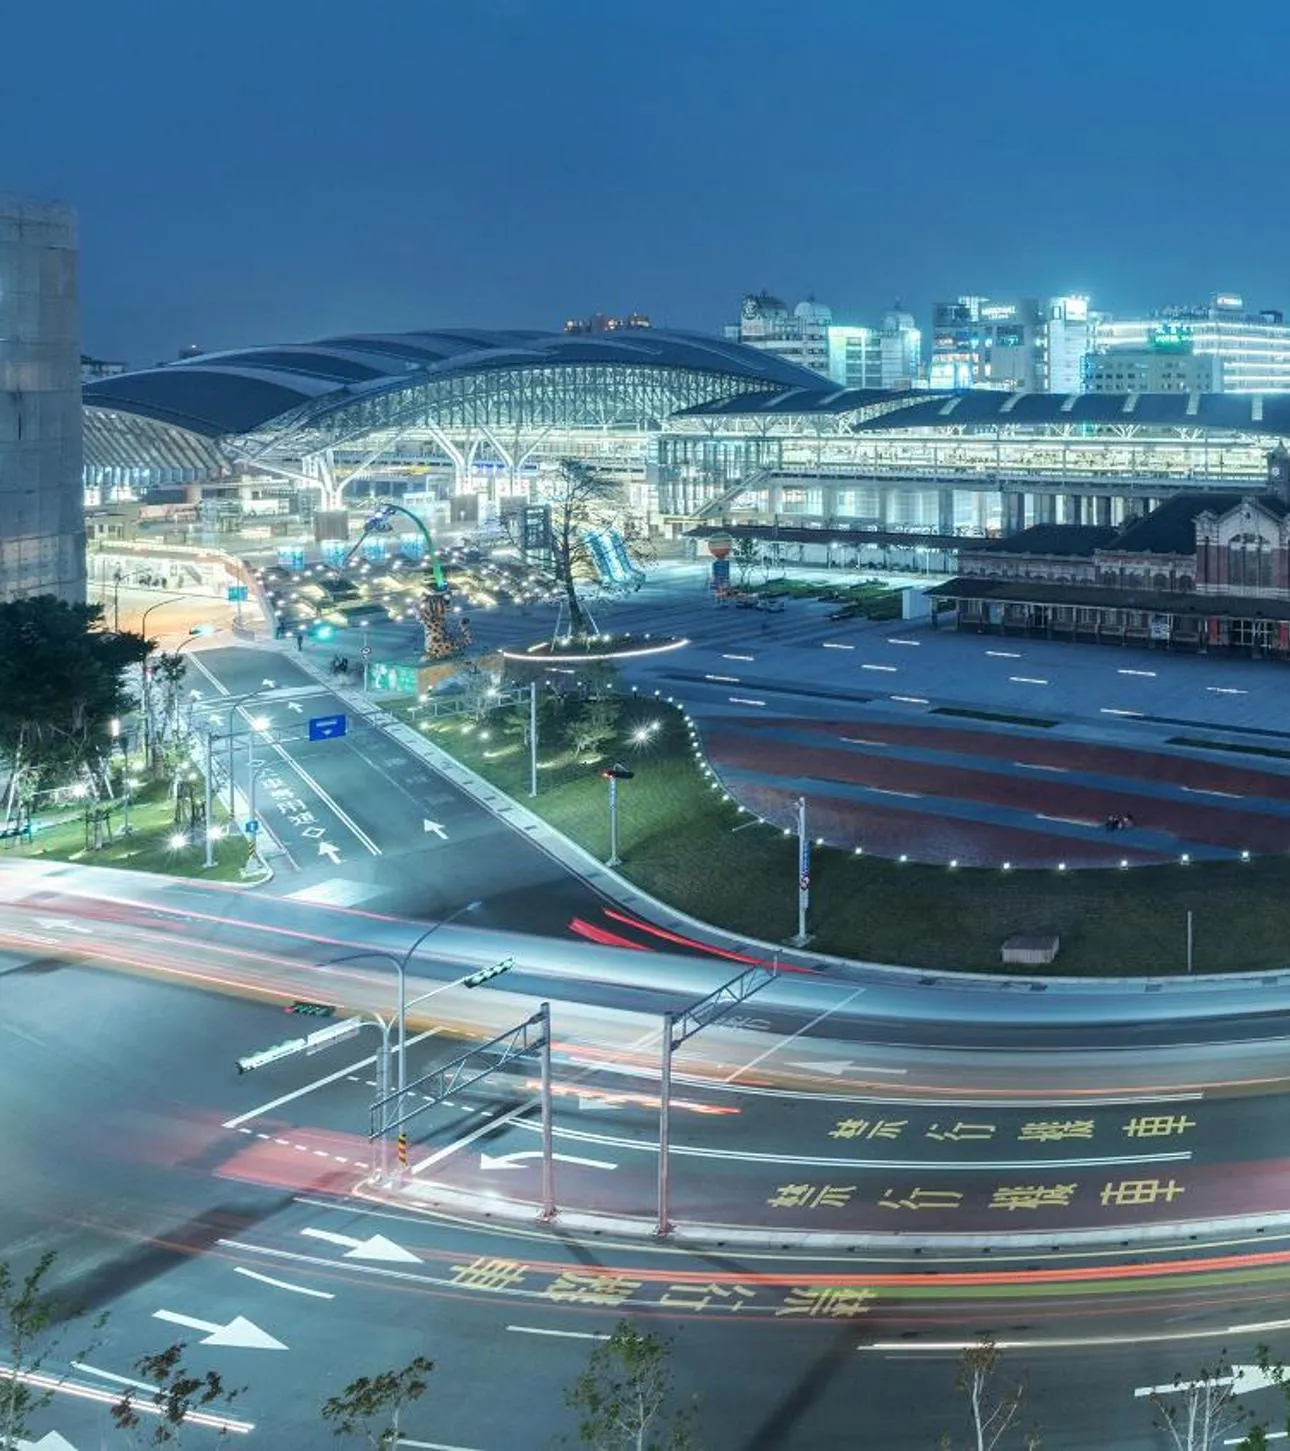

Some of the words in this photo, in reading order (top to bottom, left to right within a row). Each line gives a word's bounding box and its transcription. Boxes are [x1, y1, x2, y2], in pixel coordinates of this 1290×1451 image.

[828, 1114, 1196, 1142] 禁行機車
[768, 1178, 1186, 1210] 禁行機車
[451, 1257, 876, 1316] 禁行機車
